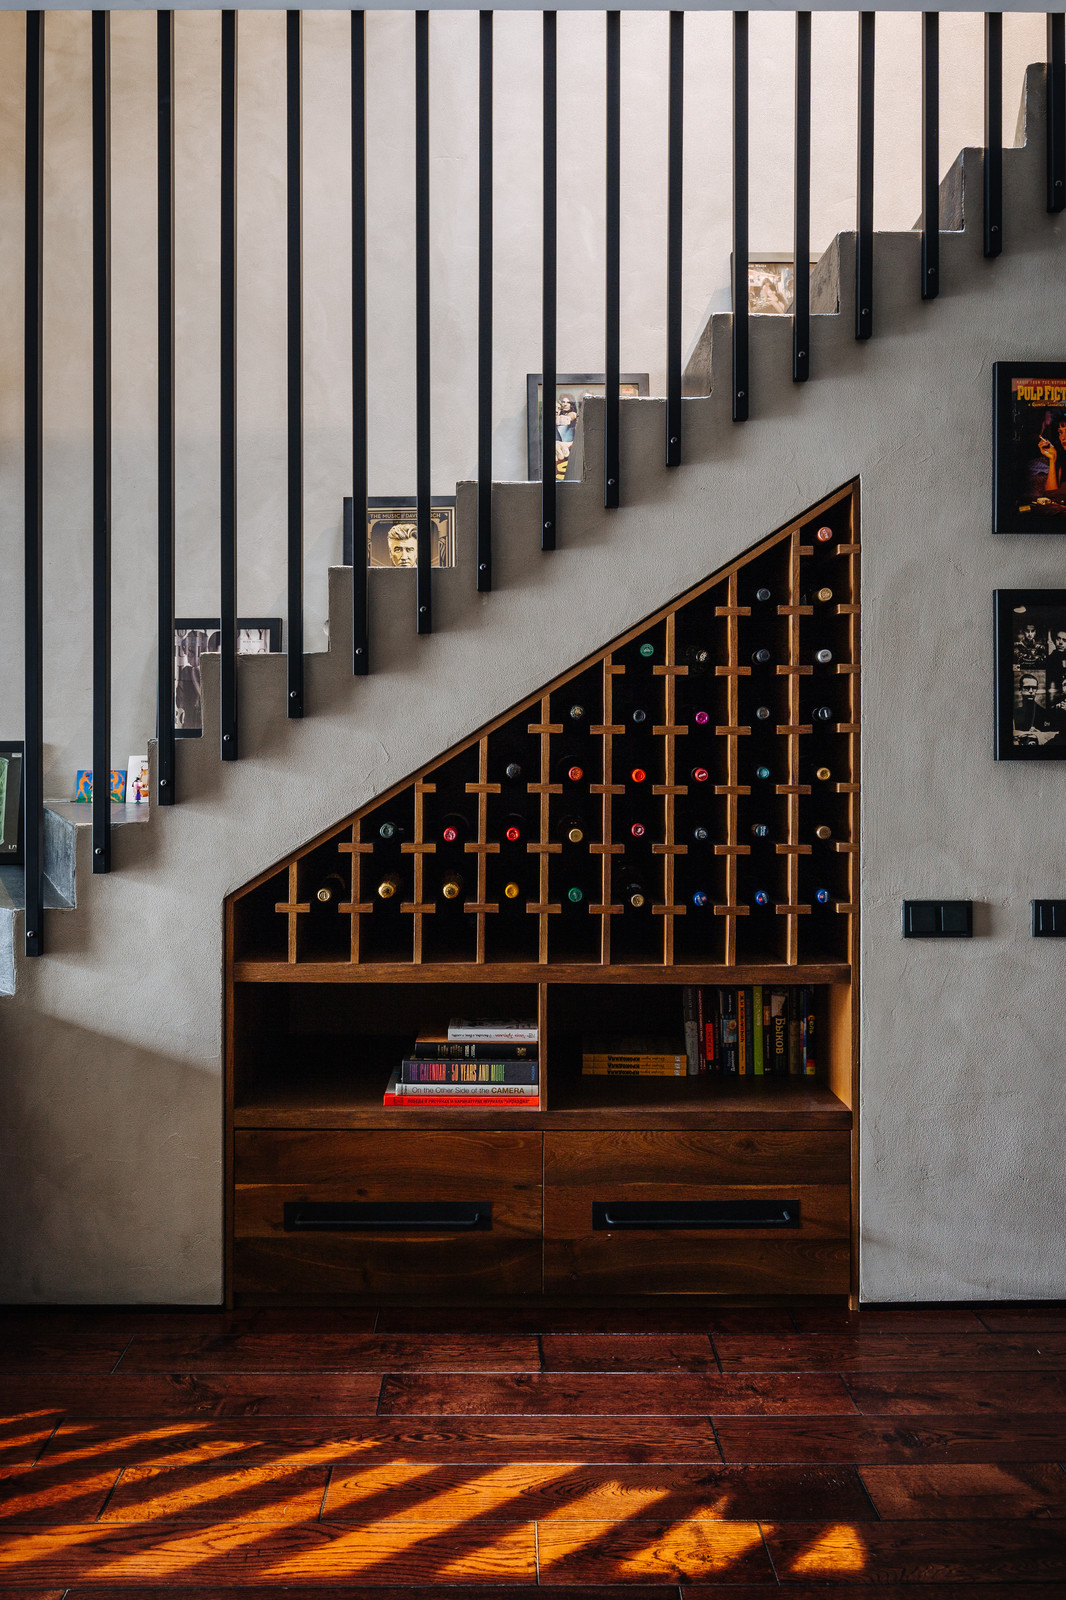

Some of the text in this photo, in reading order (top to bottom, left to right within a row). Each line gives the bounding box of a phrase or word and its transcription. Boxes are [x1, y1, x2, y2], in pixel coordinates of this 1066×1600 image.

[1017, 386, 1043, 400] PULP
[775, 1017, 786, 1054] Быков
[409, 1064, 505, 1081] THE CALENDAR 50 YEARS AND MORE
